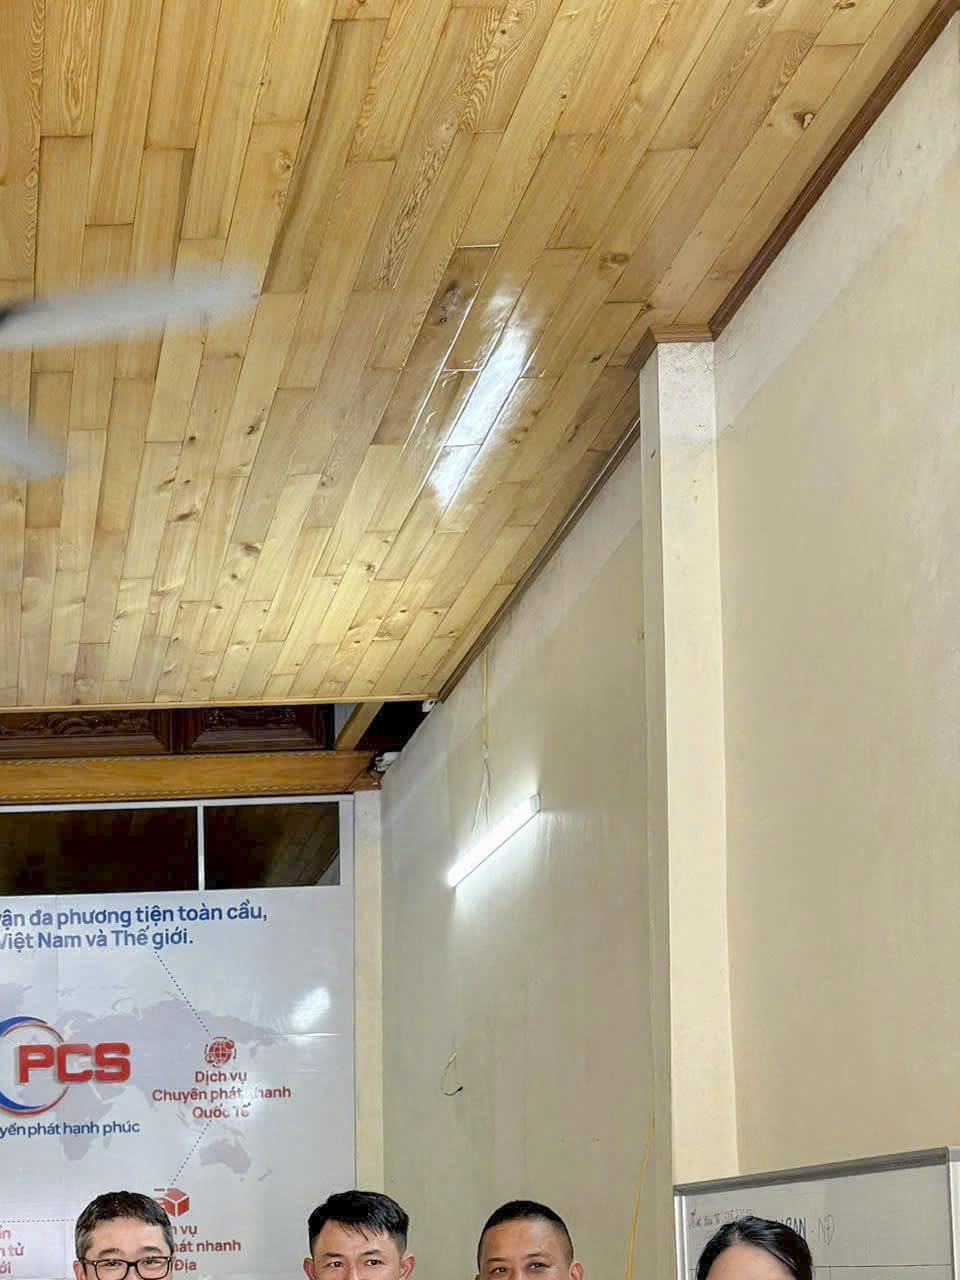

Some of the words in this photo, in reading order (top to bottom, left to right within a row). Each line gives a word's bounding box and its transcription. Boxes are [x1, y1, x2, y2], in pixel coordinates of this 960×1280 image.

[29, 910, 54, 927] đa
[56, 908, 132, 930] phương
[135, 905, 175, 927] tiện
[179, 903, 223, 922] toàn
[226, 898, 268, 922] cầu,
[37, 932, 82, 950] Nam
[85, 929, 108, 949] và
[111, 925, 150, 947] Thế
[152, 926, 194, 951] giới.
[17, 1041, 131, 1084] PCS
[194, 1070, 227, 1085] Dịch
[230, 1071, 247, 1084] vụ
[210, 1085, 242, 1103] phát
[27, 1121, 61, 1139] phát
[63, 1120, 100, 1136] hạnh
[103, 1120, 140, 1137] phúc
[180, 1225, 198, 1238] vụ
[196, 1239, 242, 1253] nhanh
